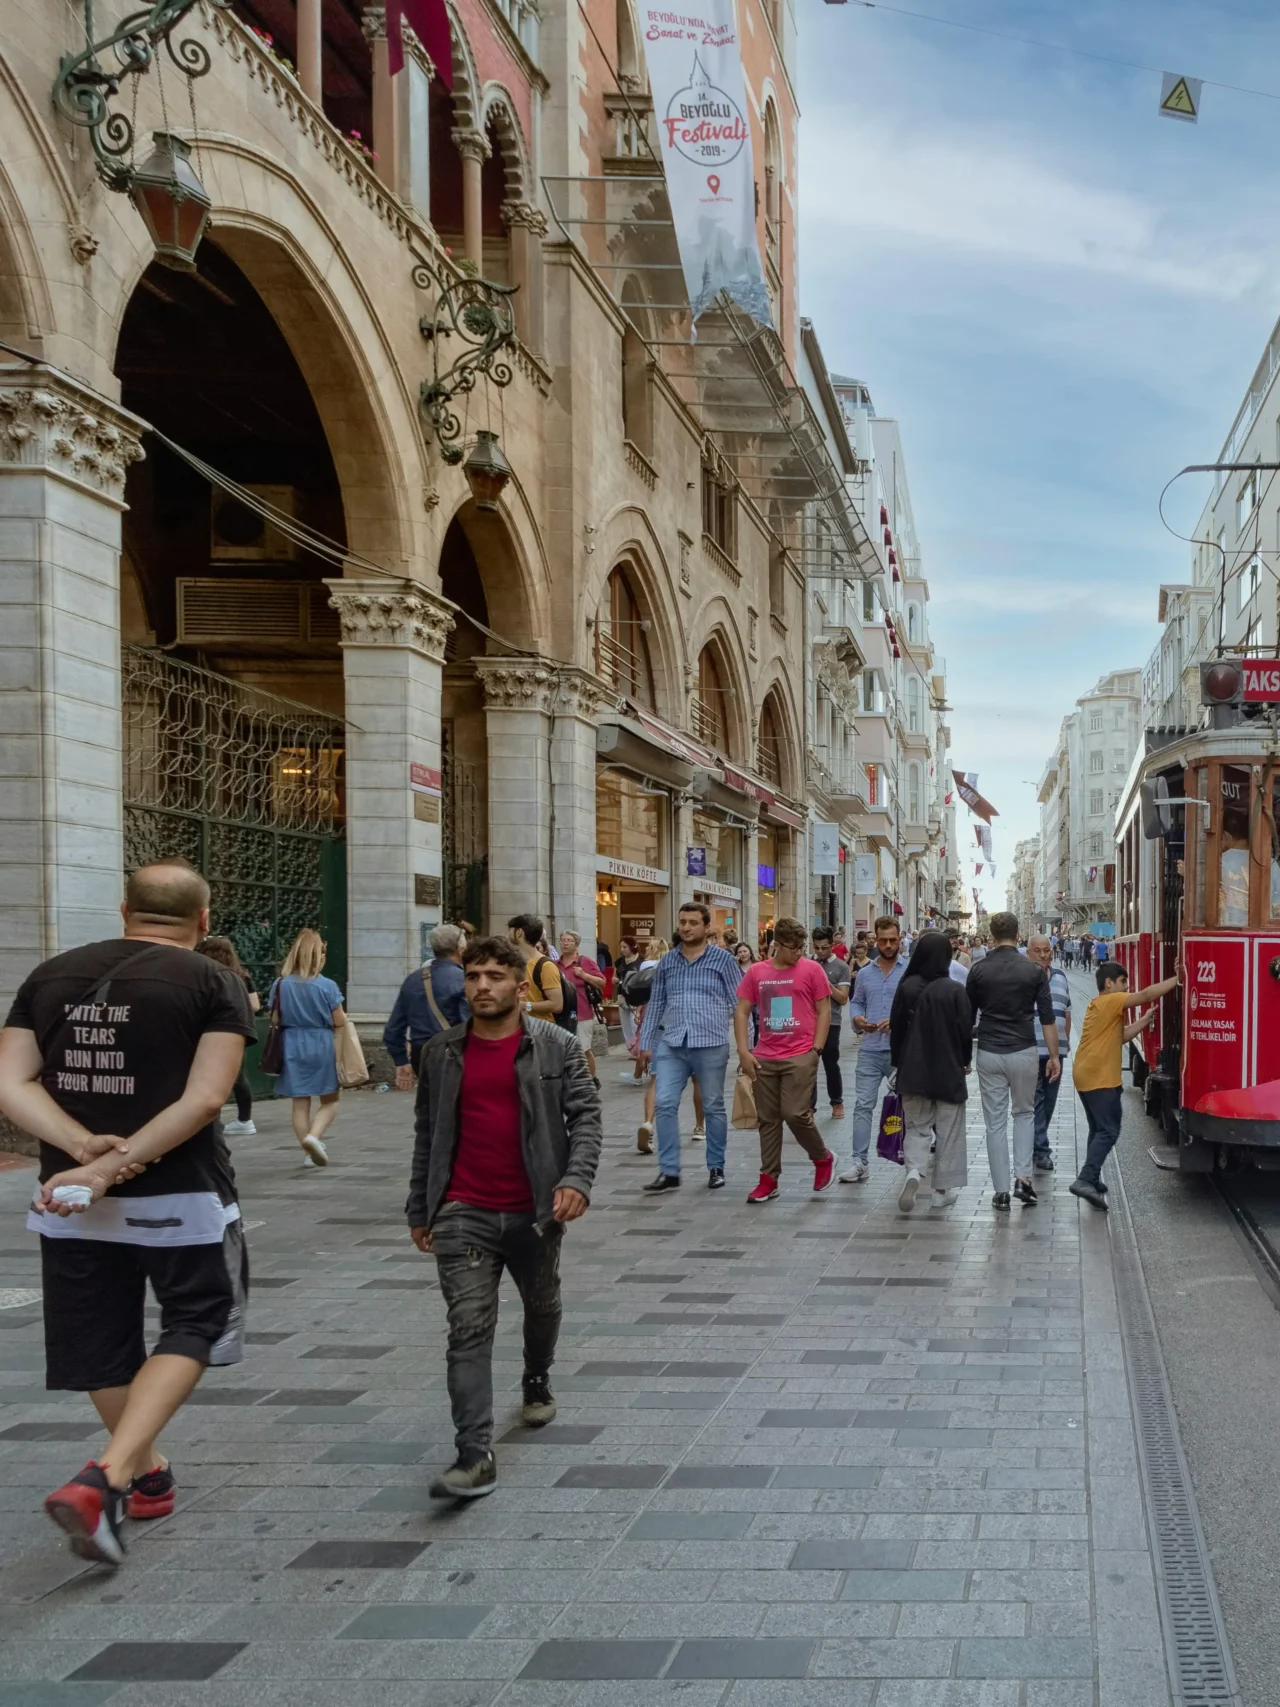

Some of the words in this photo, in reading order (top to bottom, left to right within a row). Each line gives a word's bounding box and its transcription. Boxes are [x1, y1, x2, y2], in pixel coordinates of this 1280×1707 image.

[645, 24, 684, 41] Sanat
[686, 32, 698, 41] ve
[680, 100, 731, 119] BEYOĞLU
[662, 116, 749, 148] Festivali
[1197, 961, 1216, 983] 223
[107, 1005, 131, 1022] THE
[1212, 1001, 1226, 1009] 153
[1191, 1019, 1212, 1029] ASILMAK
[1213, 1020, 1235, 1029] YASAK
[73, 1026, 116, 1045] TEARS
[64, 1049, 92, 1068] RUN
[95, 1051, 125, 1070] INTO
[57, 1071, 89, 1092] YOUR
[92, 1075, 135, 1095] MOUTH
